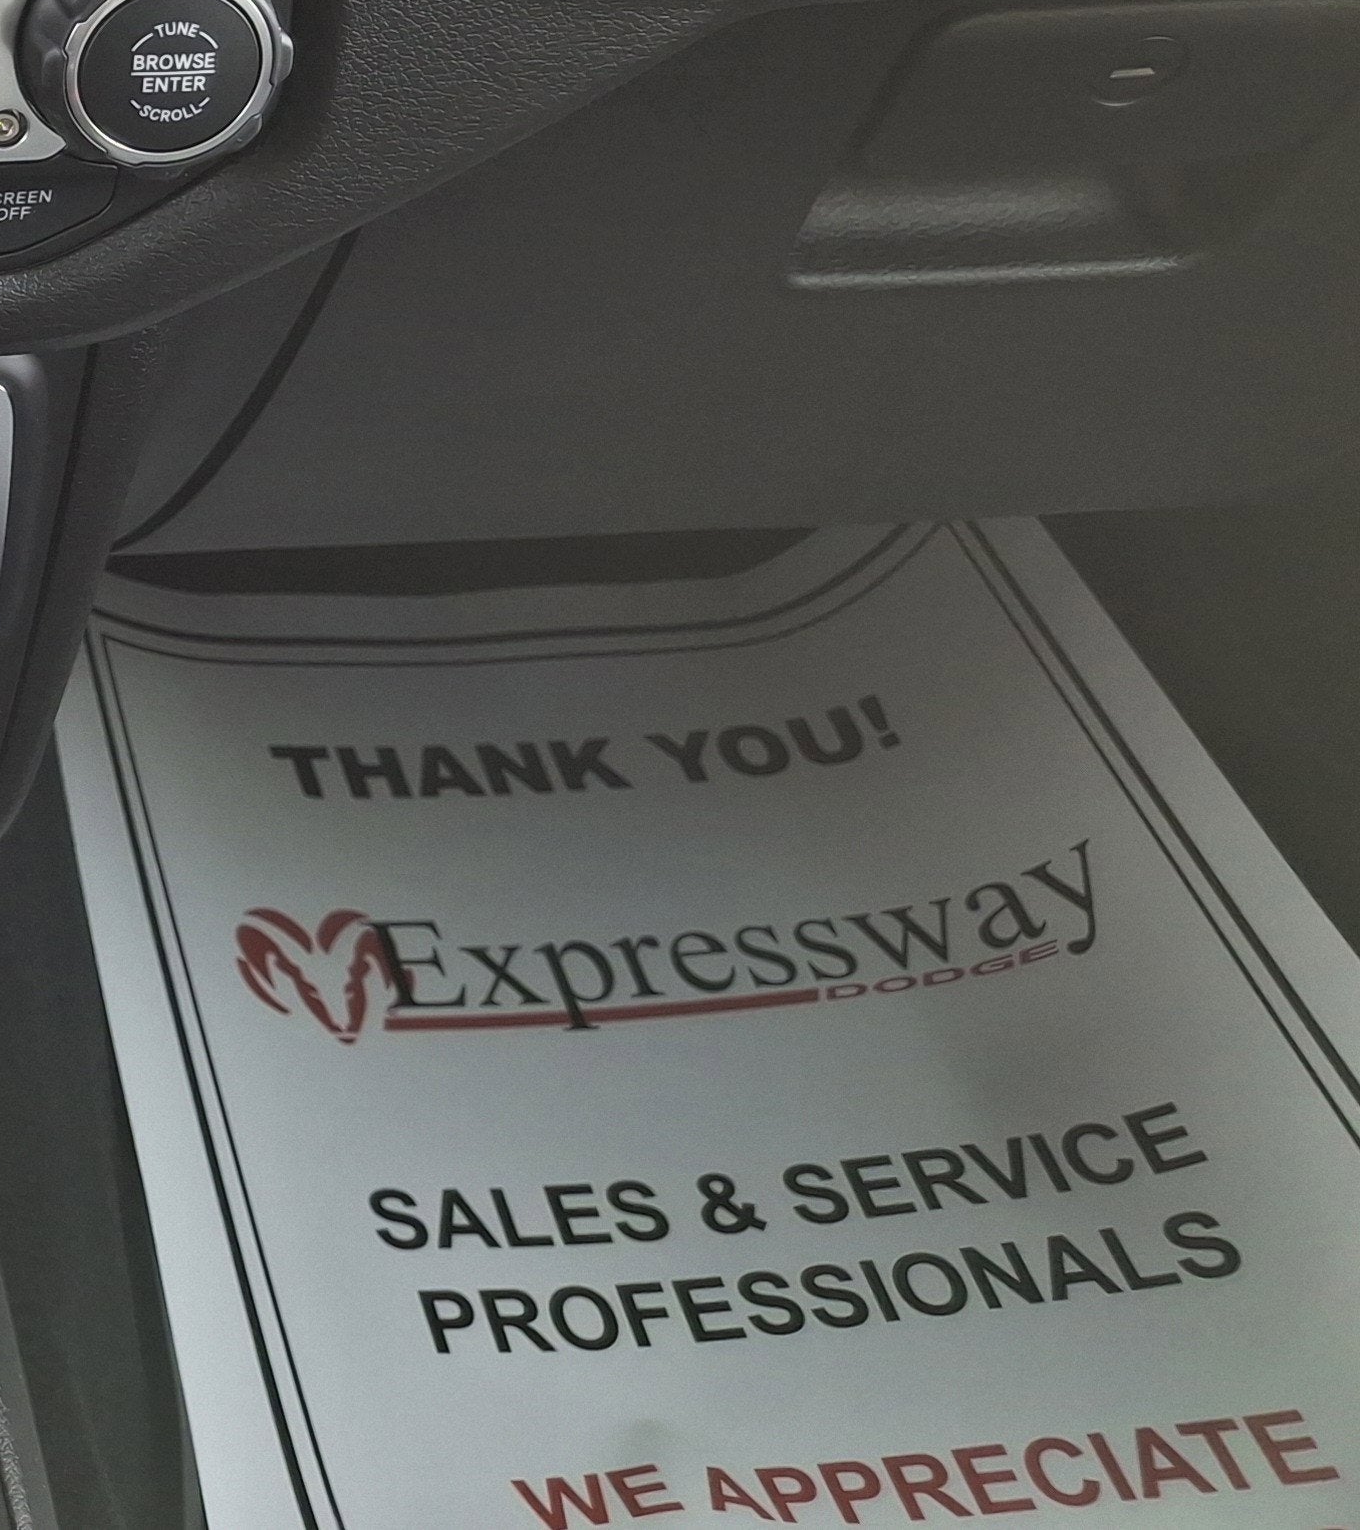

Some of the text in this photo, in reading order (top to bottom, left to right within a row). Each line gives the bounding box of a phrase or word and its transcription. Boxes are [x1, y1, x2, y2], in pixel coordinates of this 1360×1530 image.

[133, 52, 215, 70] BROWSE
[154, 21, 200, 38] TUNE
[139, 103, 203, 122] SCROLL
[142, 76, 205, 92] ENTER
[270, 697, 901, 799] THANK YOU!
[373, 839, 1102, 1031] Expressway
[826, 940, 1060, 1001] DODGE
[369, 1102, 1208, 1251] SALES & SERVICE
[418, 1211, 1242, 1354] PROFESSIONALS
[512, 1409, 1340, 1530] WE APPRECIATE
